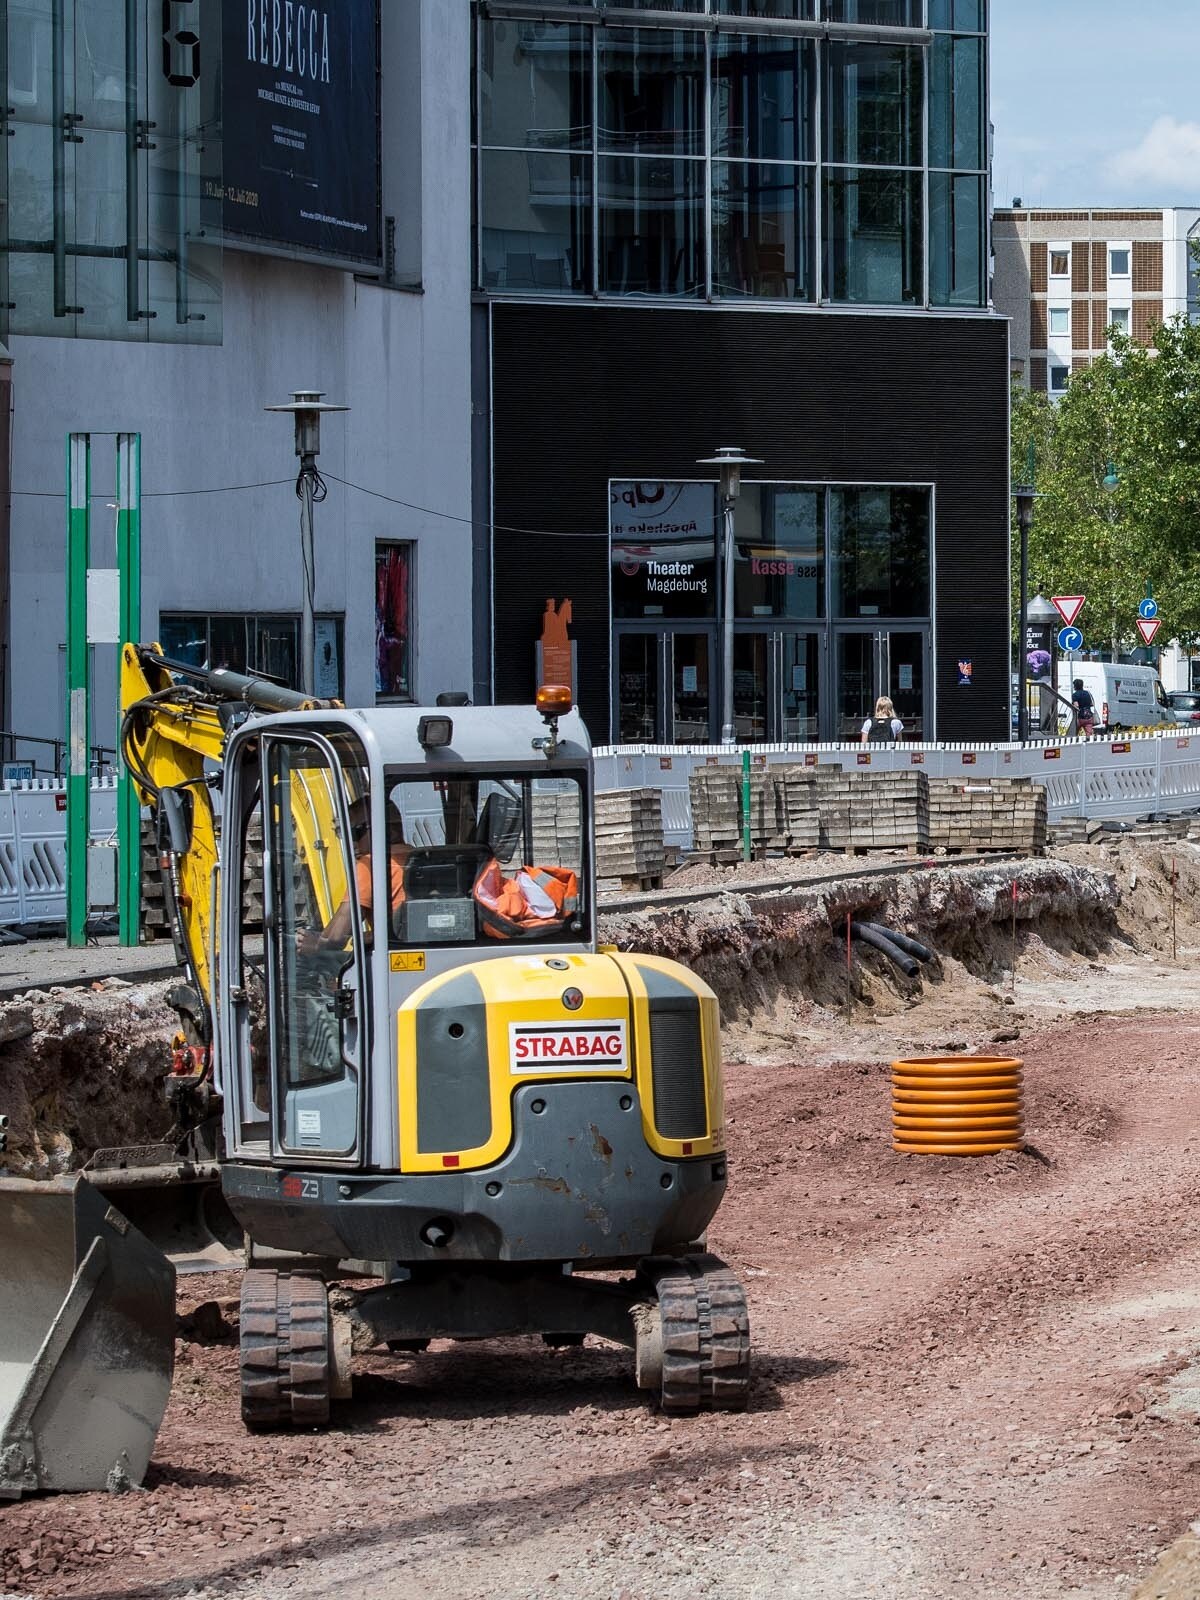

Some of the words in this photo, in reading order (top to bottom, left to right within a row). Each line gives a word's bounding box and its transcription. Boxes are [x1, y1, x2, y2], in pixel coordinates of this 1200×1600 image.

[247, 0, 330, 83] REBECCA
[646, 560, 695, 575] Theater
[751, 559, 794, 575] Kasse
[647, 578, 708, 594] Magdeburg
[515, 1035, 622, 1058] STRABAG
